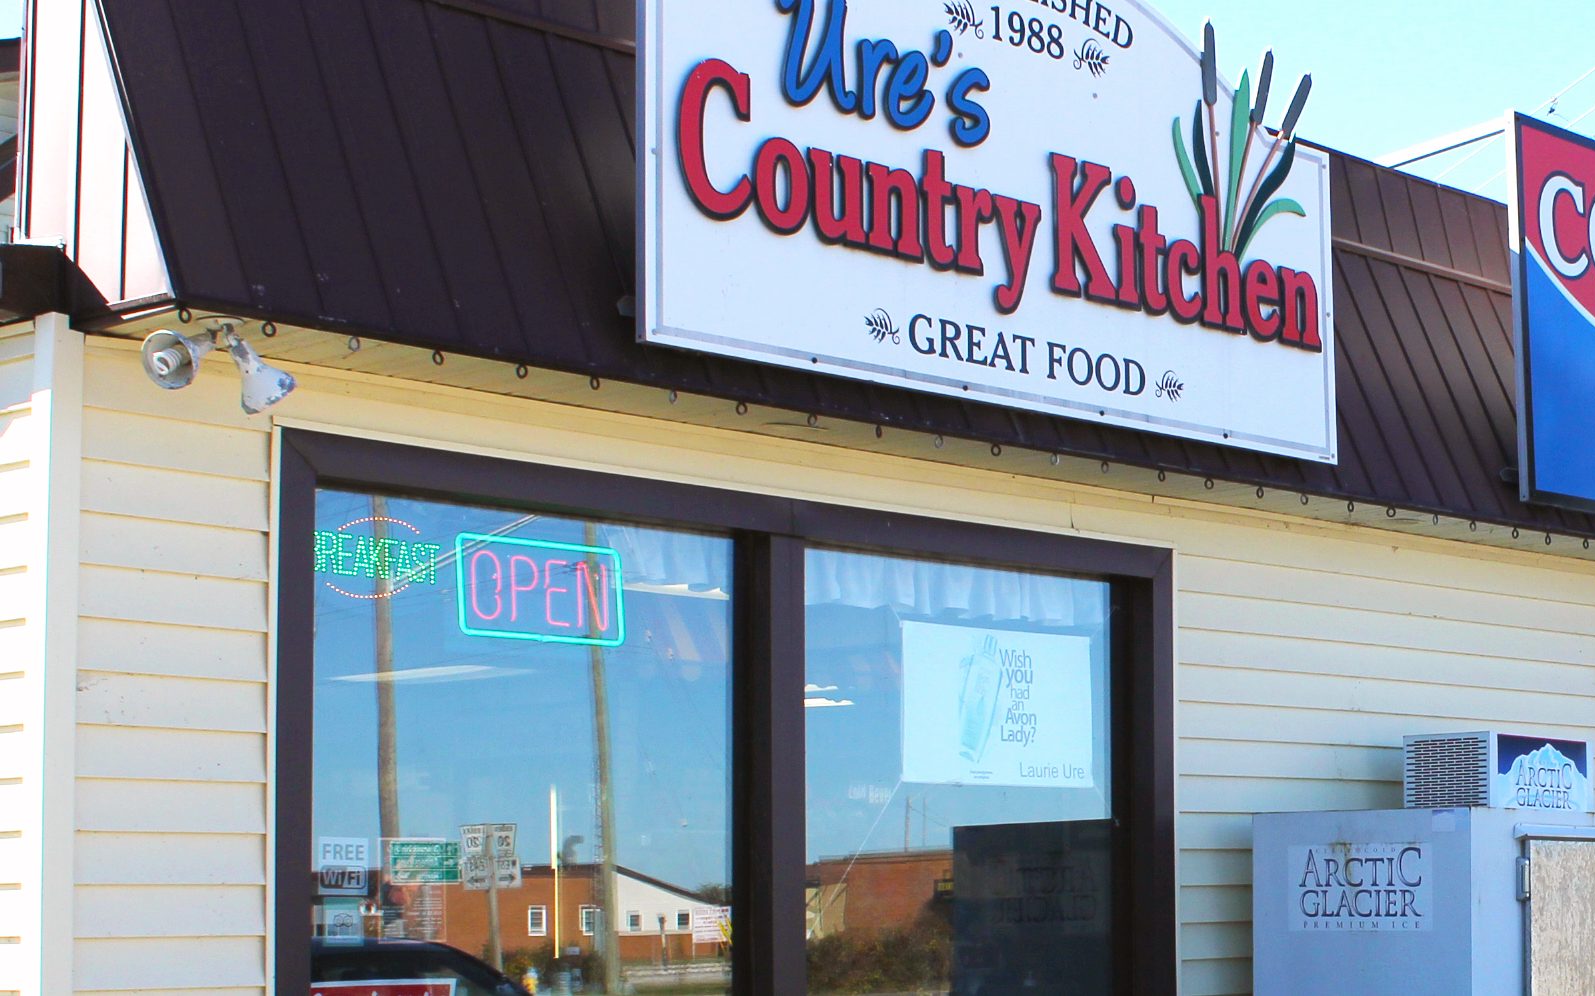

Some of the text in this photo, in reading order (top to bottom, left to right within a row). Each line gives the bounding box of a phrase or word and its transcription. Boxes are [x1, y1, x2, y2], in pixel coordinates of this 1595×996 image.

[990, 5, 1065, 60] 1988
[777, 0, 990, 147] Ure's
[678, 58, 1323, 353] Country Kitchen
[908, 313, 1147, 398] GREAT FOOD
[469, 550, 611, 632] OPEN
[999, 648, 1032, 670] Wish
[1006, 667, 1033, 688] you
[1010, 686, 1030, 700] had
[1005, 708, 1037, 726] Avon
[1011, 700, 1024, 711] an
[1000, 725, 1036, 748] Lady?
[1020, 762, 1085, 779] Laurie Ure
[1516, 759, 1573, 790] ARCTIC
[1516, 787, 1573, 810] GLACIER
[322, 843, 365, 861] FREE
[1298, 846, 1422, 888] ARCTIC
[1299, 889, 1423, 918] GLACIER
[1303, 921, 1420, 929] PREMIUM ICE
